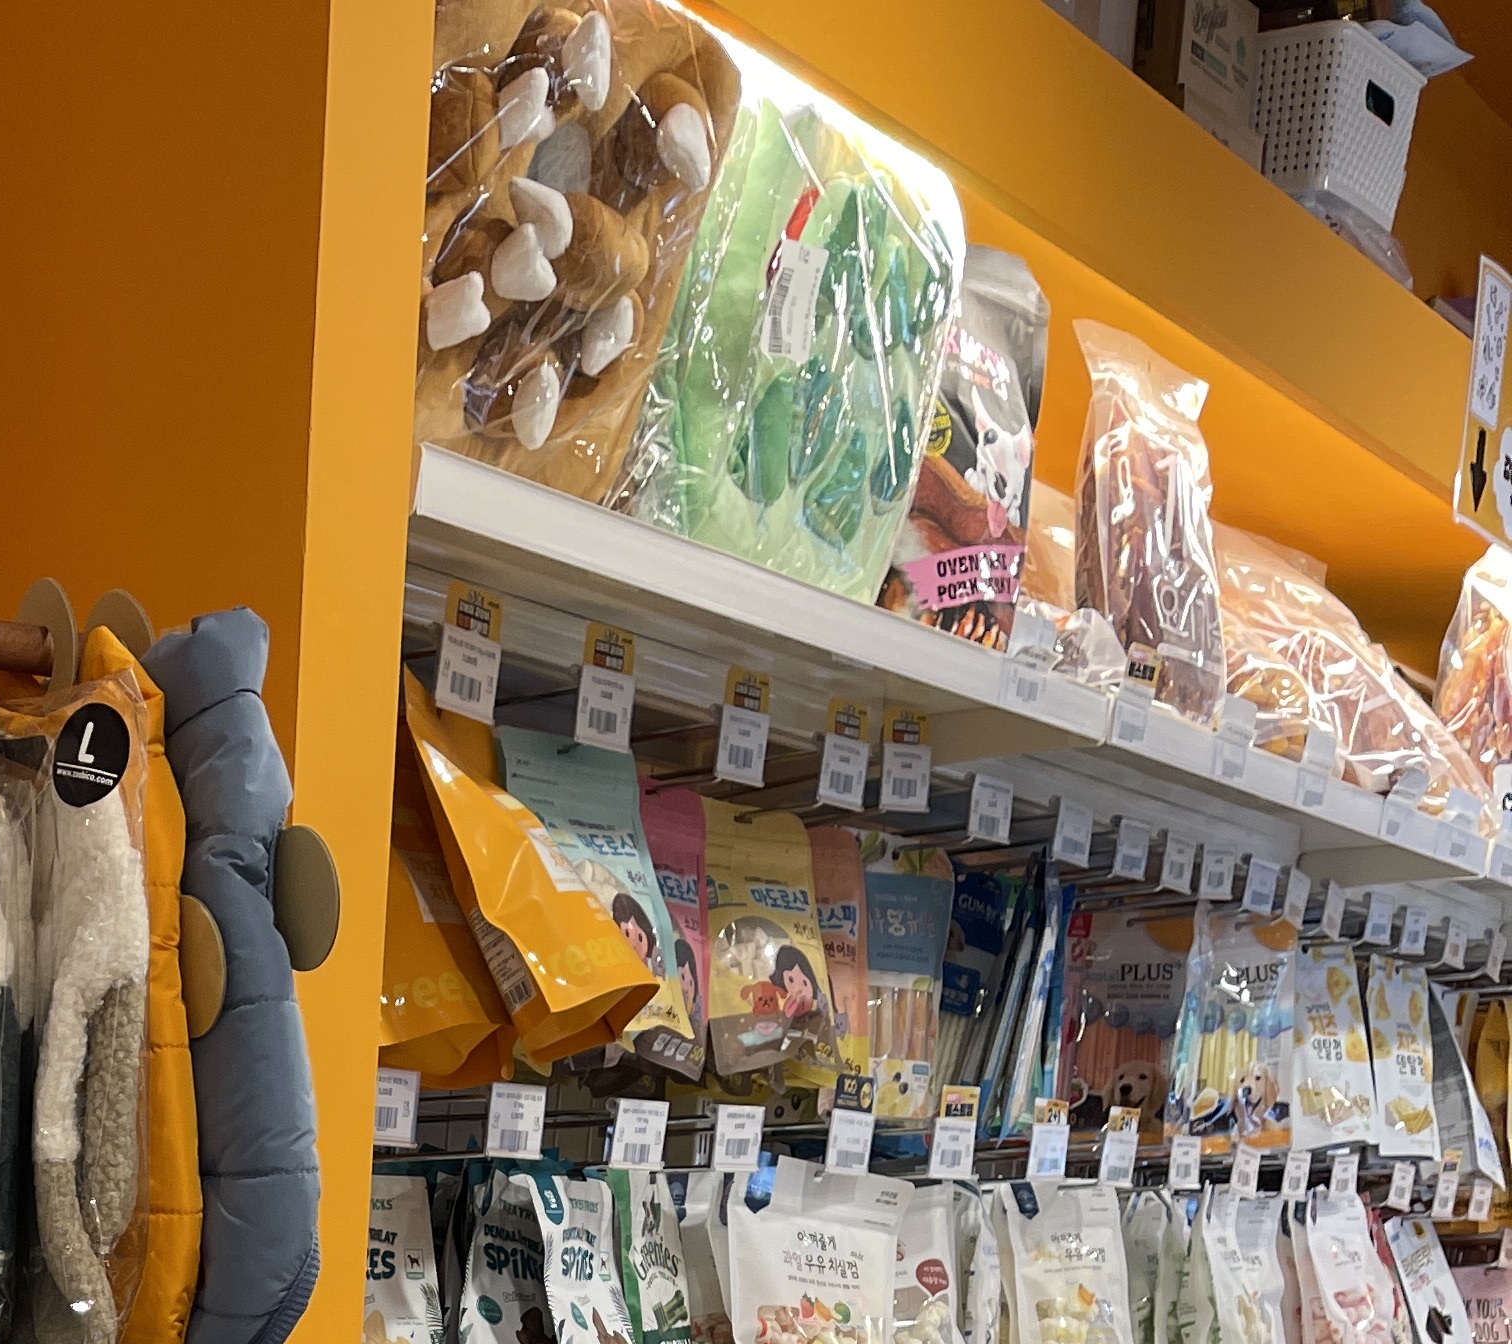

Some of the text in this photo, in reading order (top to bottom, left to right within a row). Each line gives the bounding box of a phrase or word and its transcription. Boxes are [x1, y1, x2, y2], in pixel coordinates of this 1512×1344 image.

[937, 554, 979, 578] OVEN
[77, 721, 97, 764] L
[1120, 963, 1175, 982] PLUS
[805, 1253, 826, 1273] 우유
